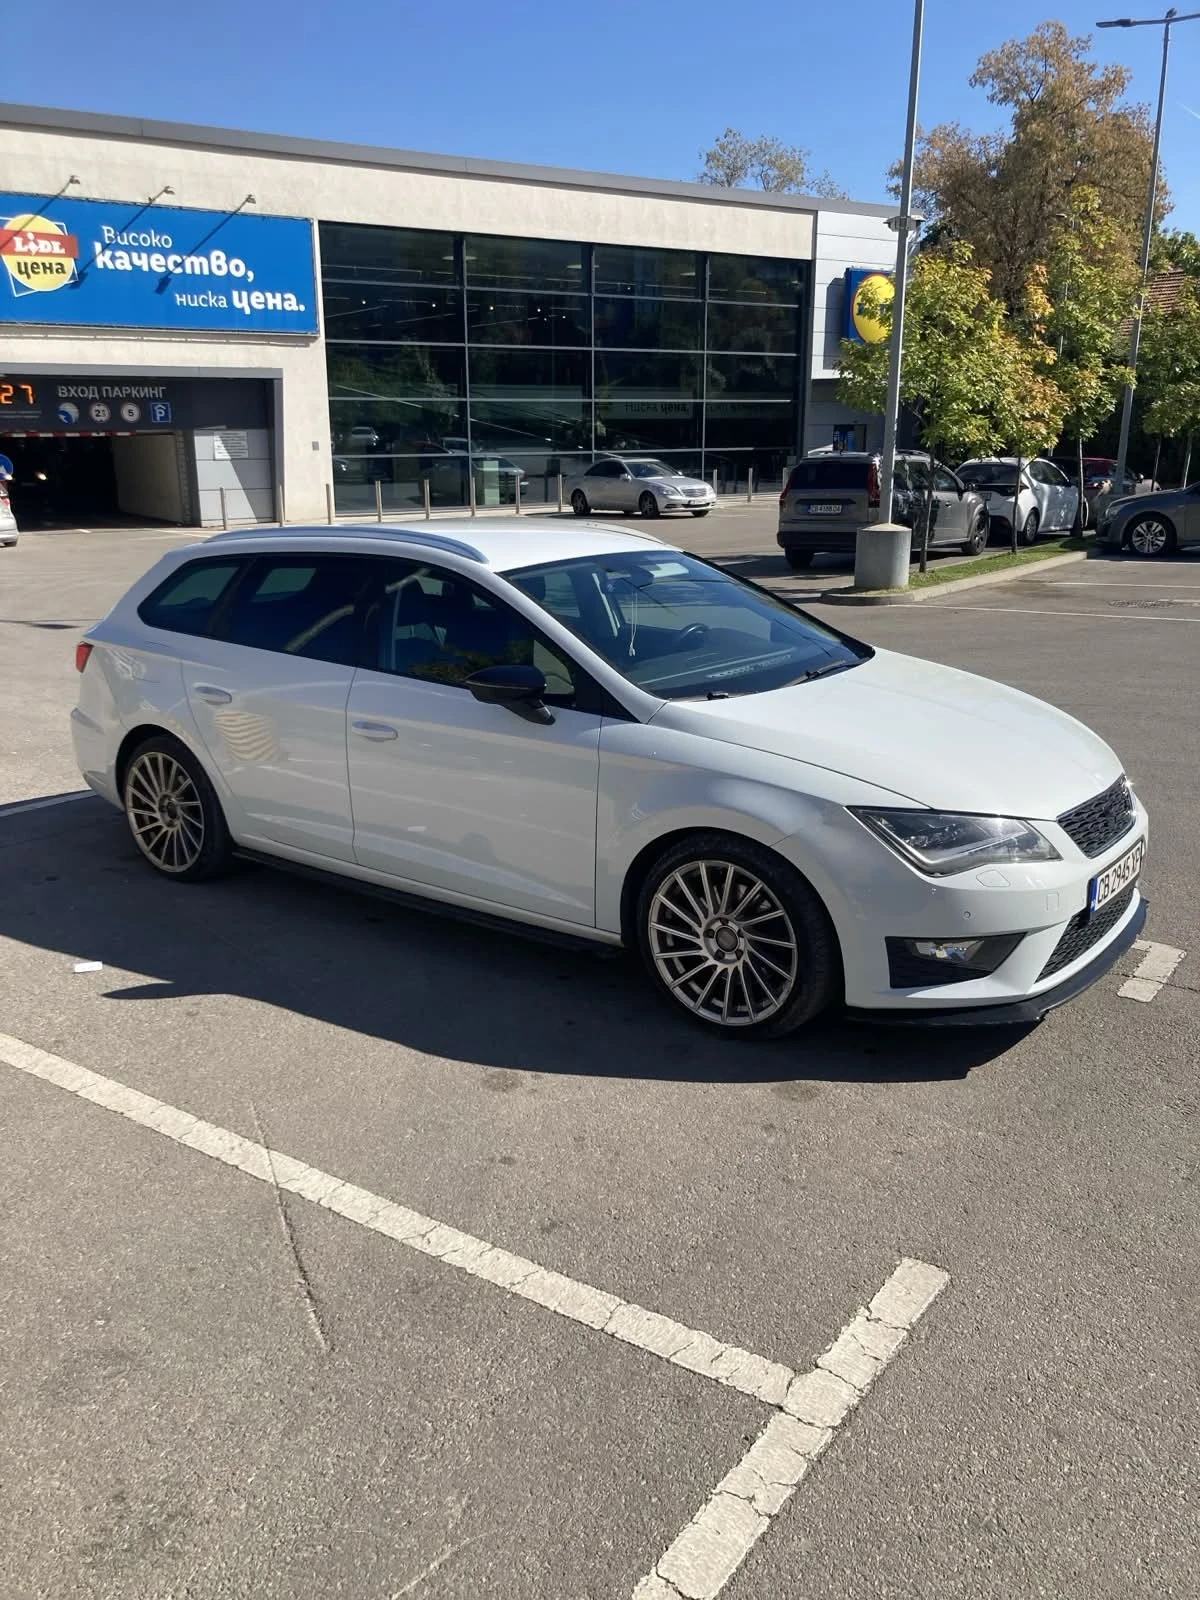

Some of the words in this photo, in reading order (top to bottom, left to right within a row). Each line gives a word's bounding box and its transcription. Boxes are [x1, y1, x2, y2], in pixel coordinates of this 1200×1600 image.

[101, 225, 173, 249] Високо
[16, 258, 66, 280] цена
[93, 242, 255, 282] качество,
[175, 291, 229, 309] ниска
[232, 289, 306, 315] цена.
[57, 385, 100, 400] ВХОД
[103, 386, 167, 399] ПАРКИНГ
[128, 409, 135, 417] 5
[1097, 873, 1110, 903] CB
